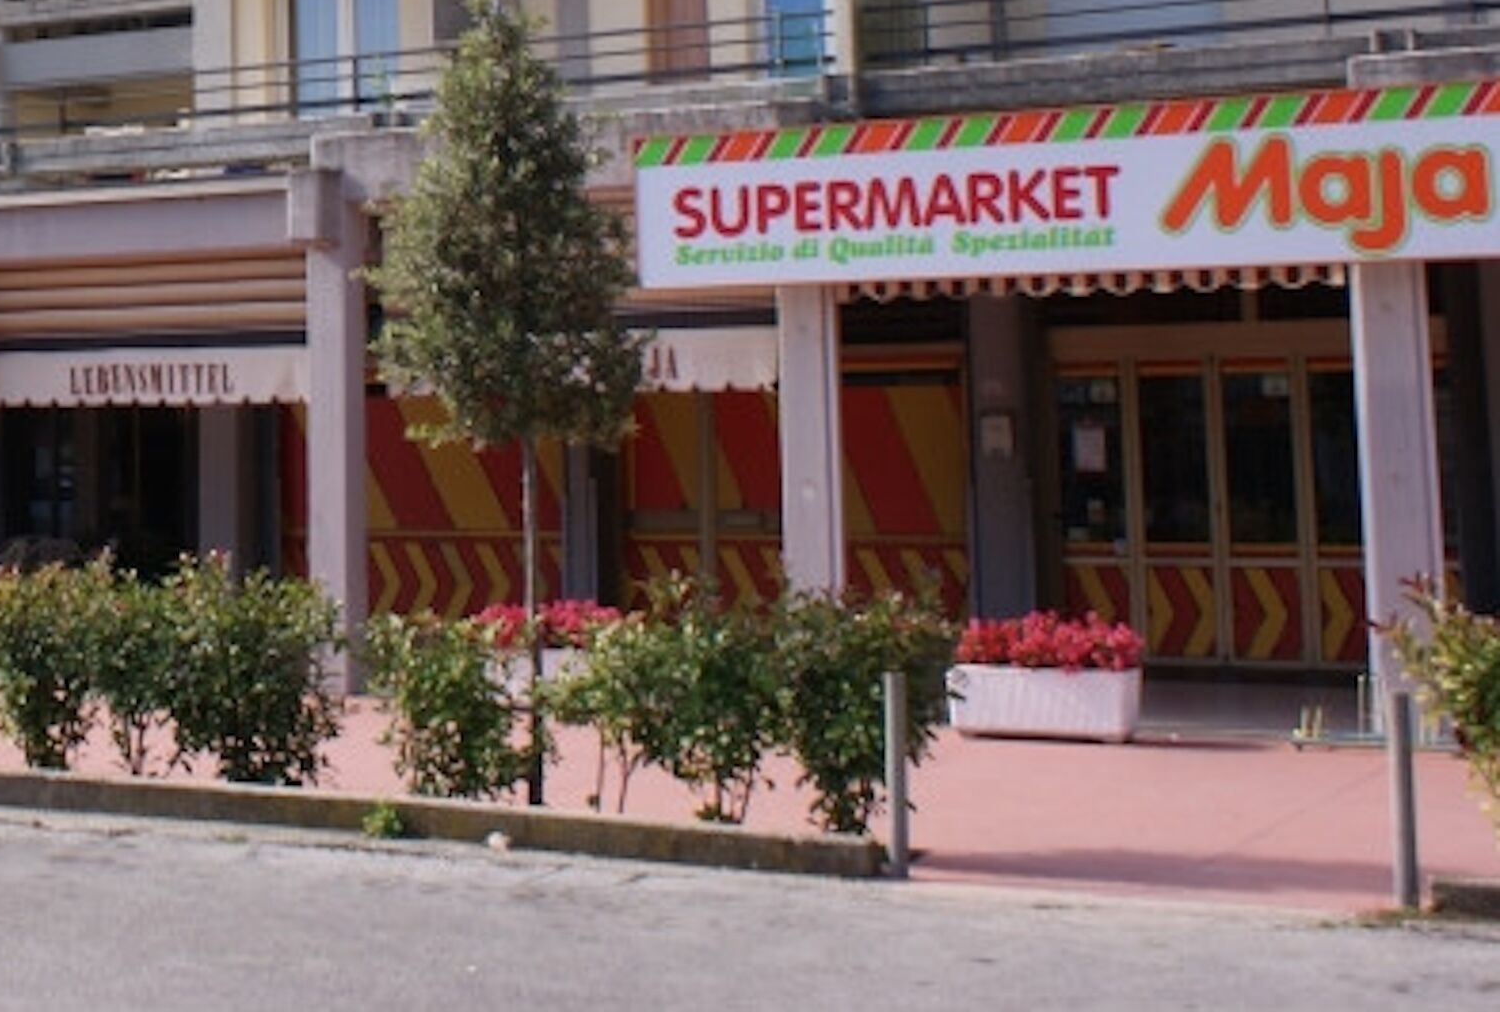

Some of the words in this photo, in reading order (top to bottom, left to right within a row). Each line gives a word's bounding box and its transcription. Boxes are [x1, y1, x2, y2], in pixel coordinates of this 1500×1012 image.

[672, 165, 1121, 239] SUPERMARKET
[1160, 134, 1491, 252] Maja
[675, 243, 785, 266] Servizio
[792, 238, 819, 260] di
[648, 344, 678, 380] JA
[70, 364, 235, 395] LEBENSMITTEL
